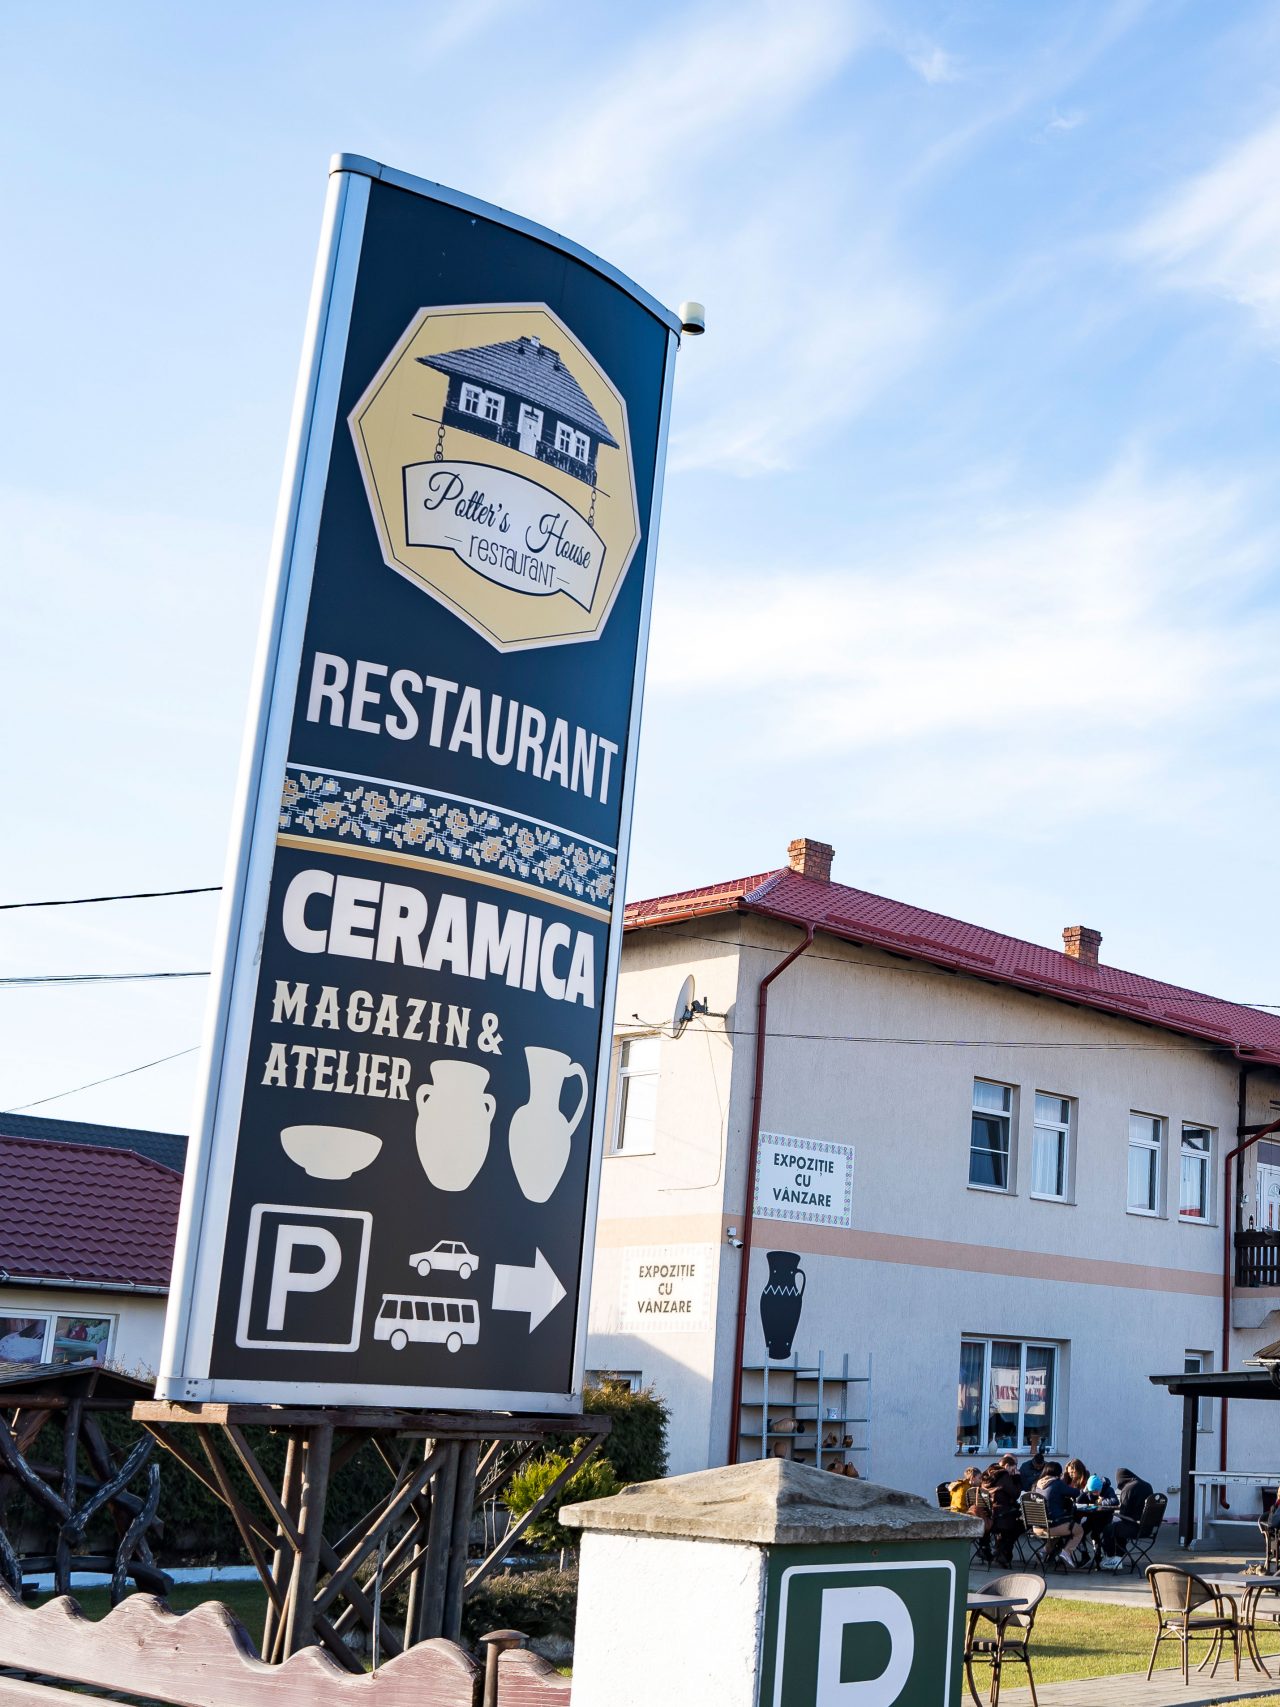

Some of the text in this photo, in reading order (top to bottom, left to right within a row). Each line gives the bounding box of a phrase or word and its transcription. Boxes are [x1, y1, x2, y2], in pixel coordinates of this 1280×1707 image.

[424, 471, 591, 568] Potter's House
[306, 652, 618, 804] RESTAURANT
[282, 869, 595, 1009] CERAMICA
[270, 980, 503, 1055] MAGAZIN &
[261, 1042, 411, 1100] ATELIER
[772, 1186, 831, 1208] VÂNZARE
[794, 1173, 811, 1187] CU
[266, 1224, 342, 1331] P
[658, 1282, 673, 1295] CU
[815, 1585, 915, 1707] P
